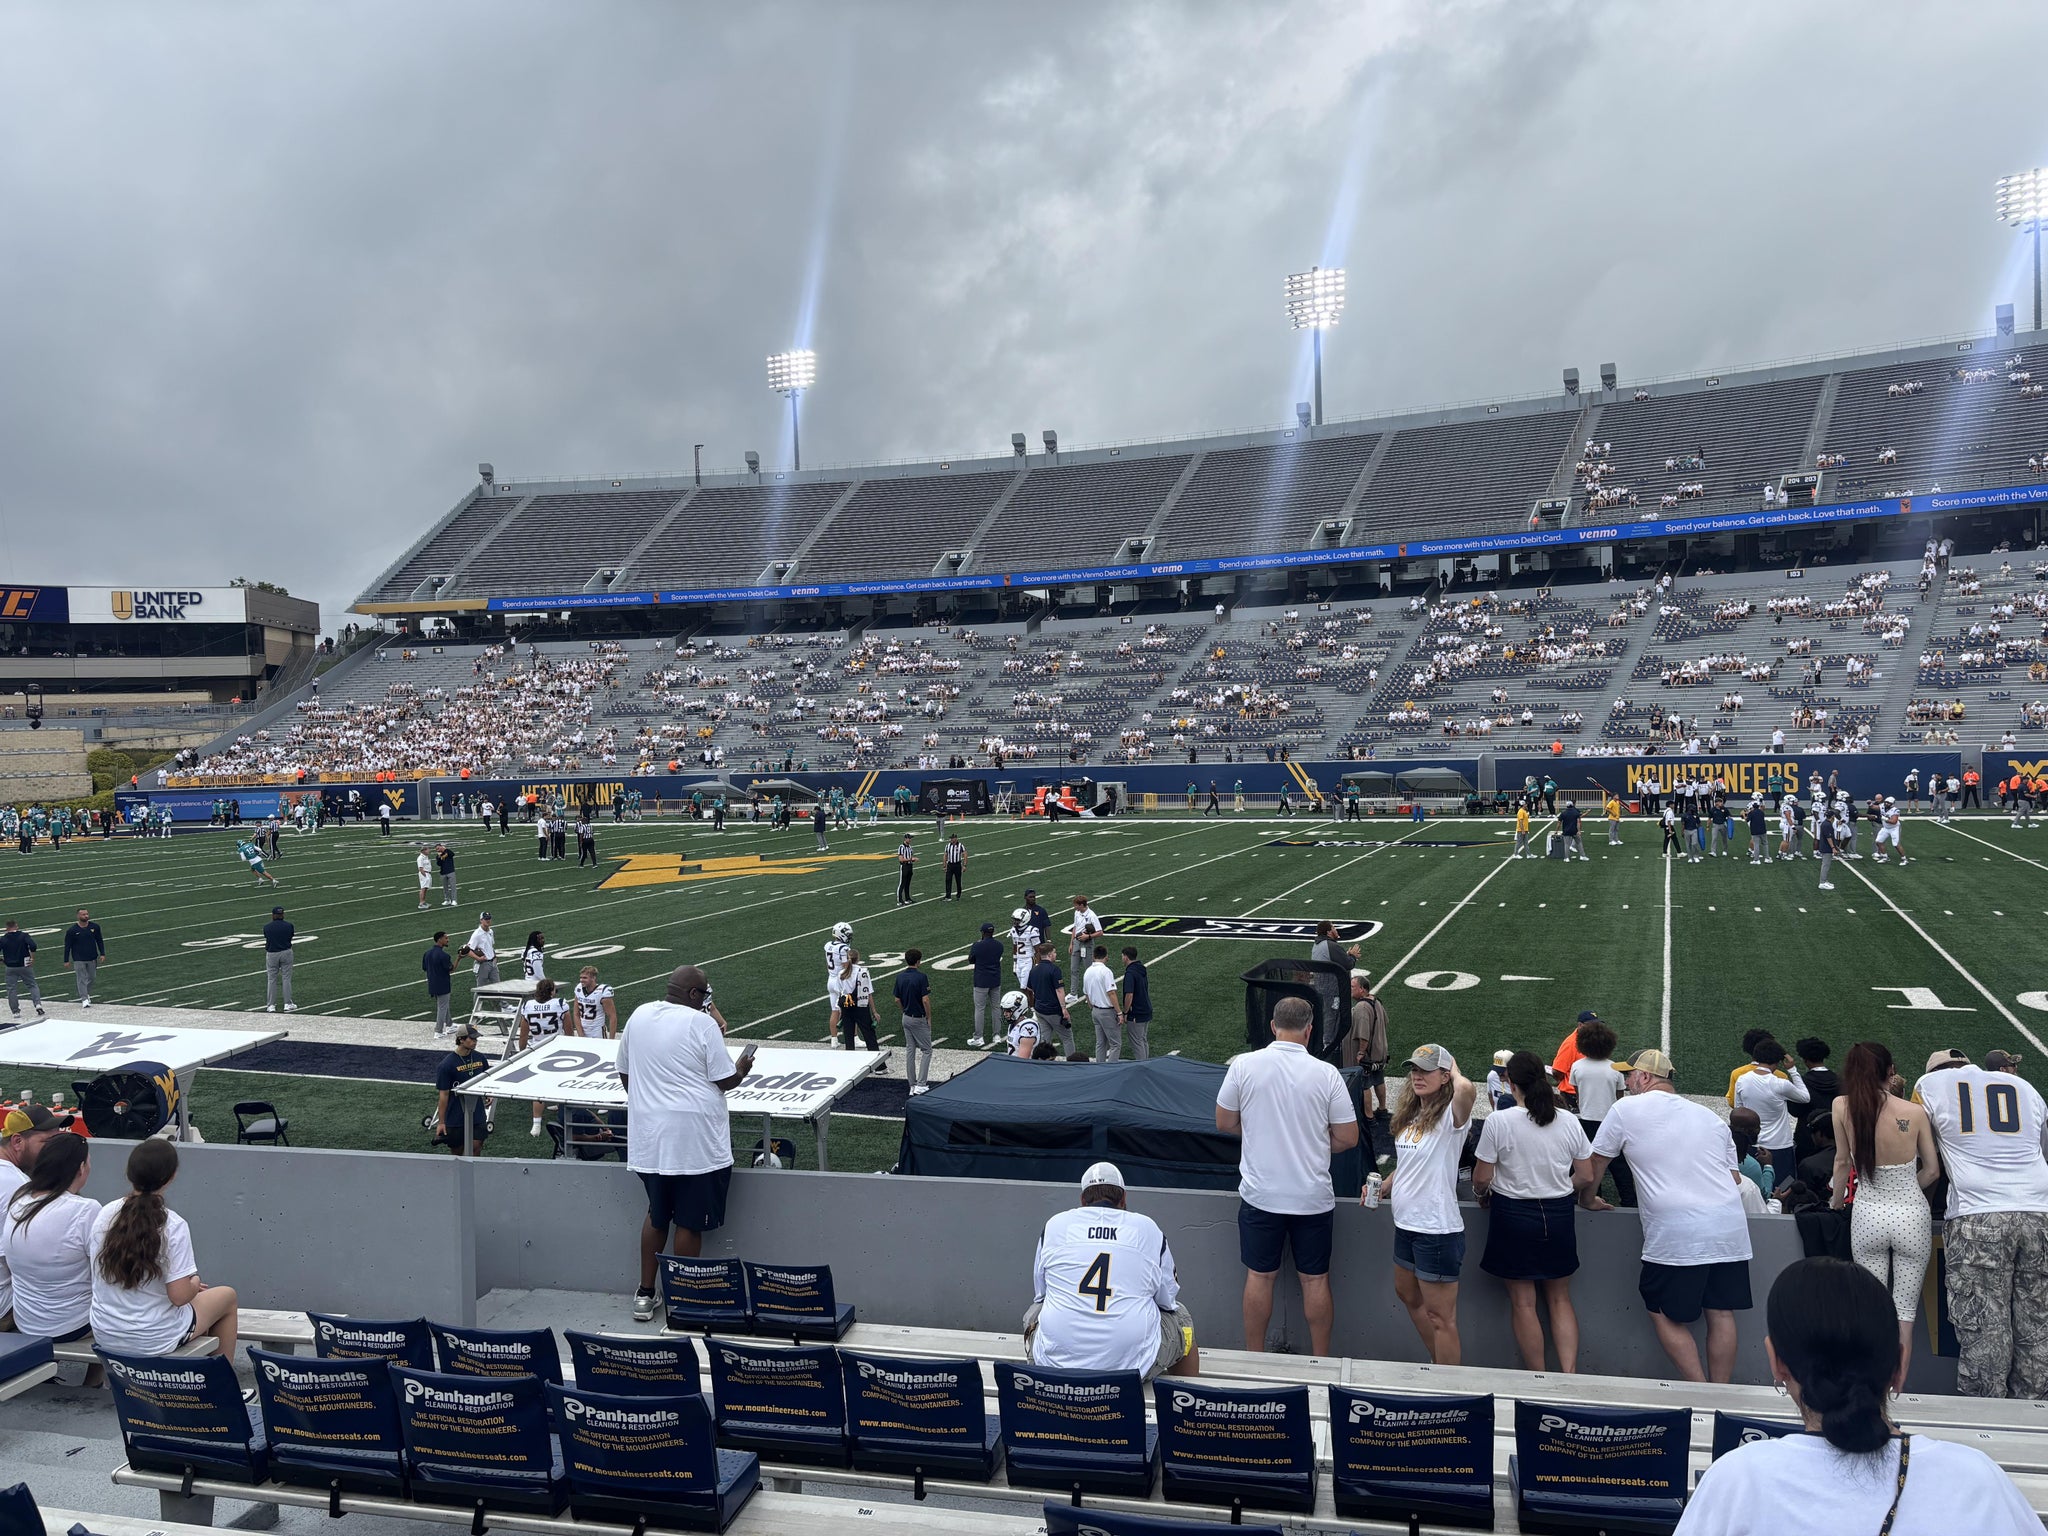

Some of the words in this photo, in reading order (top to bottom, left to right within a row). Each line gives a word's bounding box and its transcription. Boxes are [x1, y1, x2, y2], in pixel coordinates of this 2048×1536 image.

[1932, 498, 1960, 508] Score
[1961, 496, 1986, 505] more
[1988, 492, 2009, 502] with
[2011, 491, 2027, 500] the
[1666, 522, 1691, 533] Spend
[1693, 522, 1711, 531] your
[1712, 519, 1747, 528] balance.
[1749, 516, 1764, 525] Get
[1766, 514, 1786, 523] cash
[1788, 511, 1811, 521] back.
[1814, 510, 1834, 519] Love
[1837, 507, 1854, 517] that
[1856, 505, 1882, 515] math.
[1579, 529, 1617, 540] venmo
[1152, 566, 1182, 575] venmo
[134, 592, 202, 605] UNITED
[791, 587, 819, 596] venmo
[135, 606, 185, 619] BANK
[826, 952, 834, 970] 3
[527, 1013, 559, 1035] 53
[1958, 1082, 2020, 1134] 10
[1088, 1227, 1117, 1240] COOK
[679, 1264, 728, 1273] Panhandle
[767, 1270, 817, 1280] Panhandle
[1078, 1252, 1113, 1313] 4
[335, 1328, 406, 1342] Panhandle
[460, 1339, 531, 1354] Panhandle
[602, 1347, 677, 1360] Panhandle
[740, 1356, 819, 1368] Panhandle
[126, 1366, 205, 1383] Panhandle
[280, 1368, 367, 1383] Panhandle
[876, 1368, 958, 1383] Panhandle
[1034, 1380, 1120, 1396] Panhandle
[425, 1386, 514, 1405] Panhandle
[425, 1401, 457, 1410] CLEANING
[465, 1401, 514, 1413] RESTORATION
[725, 1404, 827, 1417] www.mountaineerseats.com
[1195, 1398, 1286, 1413] Panhandle
[429, 1414, 456, 1423] OFFICIAL
[458, 1416, 504, 1426] RESTORATION
[586, 1406, 679, 1423] Panhandle
[1374, 1407, 1469, 1420] Panhandle
[411, 1418, 439, 1429] COMPANY
[587, 1420, 620, 1429] CLEANING
[629, 1420, 679, 1430] RESTORATION
[860, 1420, 967, 1434] www.mountaineerseats.com
[1418, 1417, 1466, 1425] RESTORATION
[274, 1425, 380, 1440] www.mountaineerseats.com
[579, 1428, 590, 1436] THE
[591, 1432, 619, 1442] OFFICIAL
[621, 1433, 670, 1443] RESTORATION
[1174, 1426, 1206, 1436] COMPANY
[1408, 1428, 1455, 1438] RESTORATION
[1566, 1422, 1667, 1436] Panhandle
[573, 1433, 600, 1448] COMPANY
[1015, 1431, 1128, 1445] www.mountaineerseats.com
[1350, 1437, 1385, 1446] COMPANY
[414, 1446, 527, 1461] www.mountaineerseats.com
[1173, 1450, 1291, 1464] www.mountaineerseats.com
[575, 1462, 692, 1478] www.mountaineerseats.com
[1348, 1463, 1473, 1473] www.mountaineerseats.com
[1536, 1474, 1669, 1487] www.mountaineerseats.com
